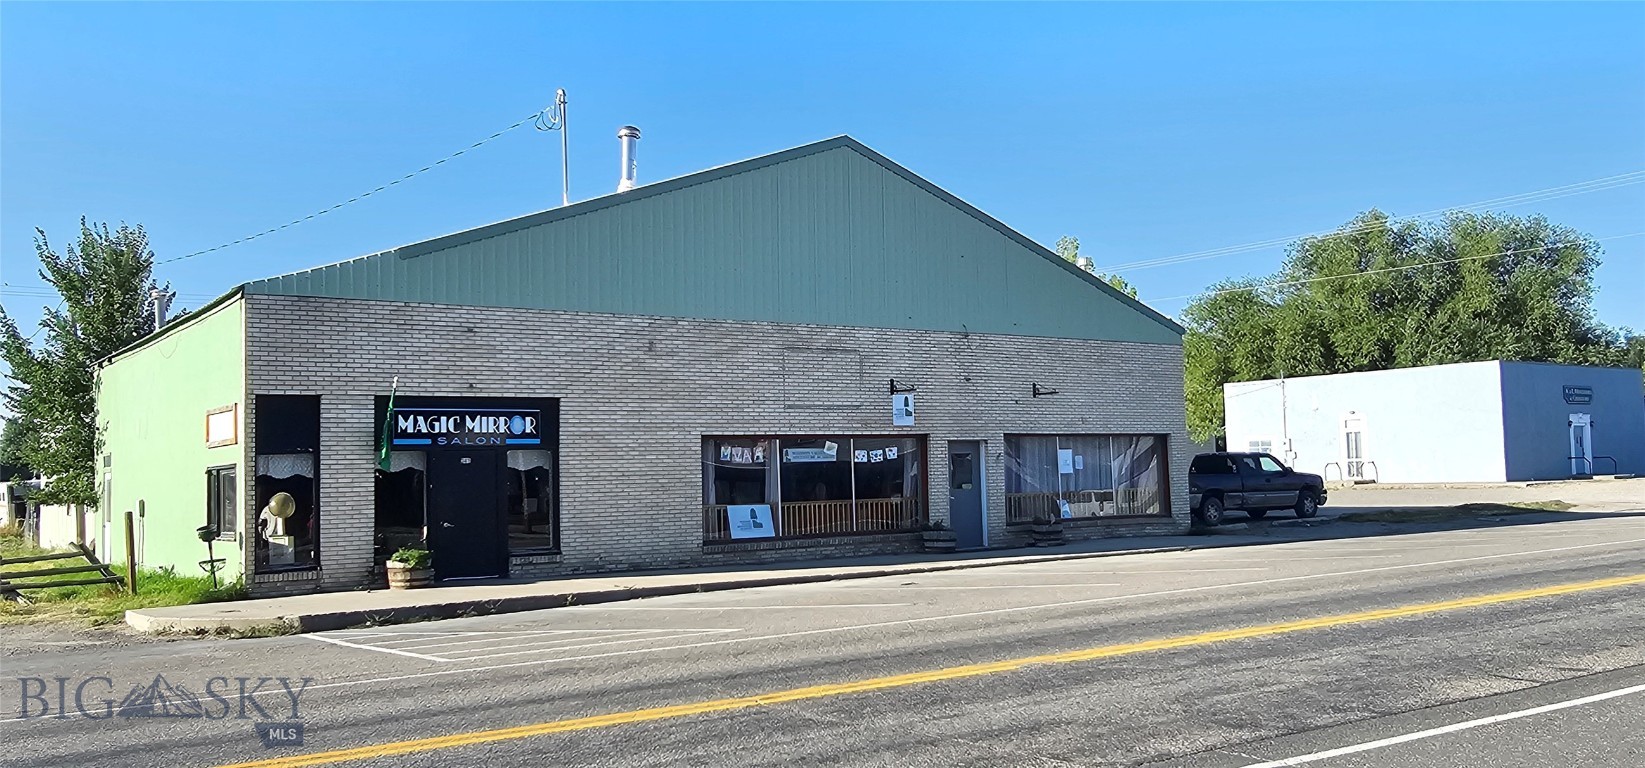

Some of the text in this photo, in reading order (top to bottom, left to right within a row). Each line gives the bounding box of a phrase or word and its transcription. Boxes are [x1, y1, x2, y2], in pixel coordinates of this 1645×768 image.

[397, 415, 537, 435] MAGIC MIRROR
[437, 437, 501, 445] SALON
